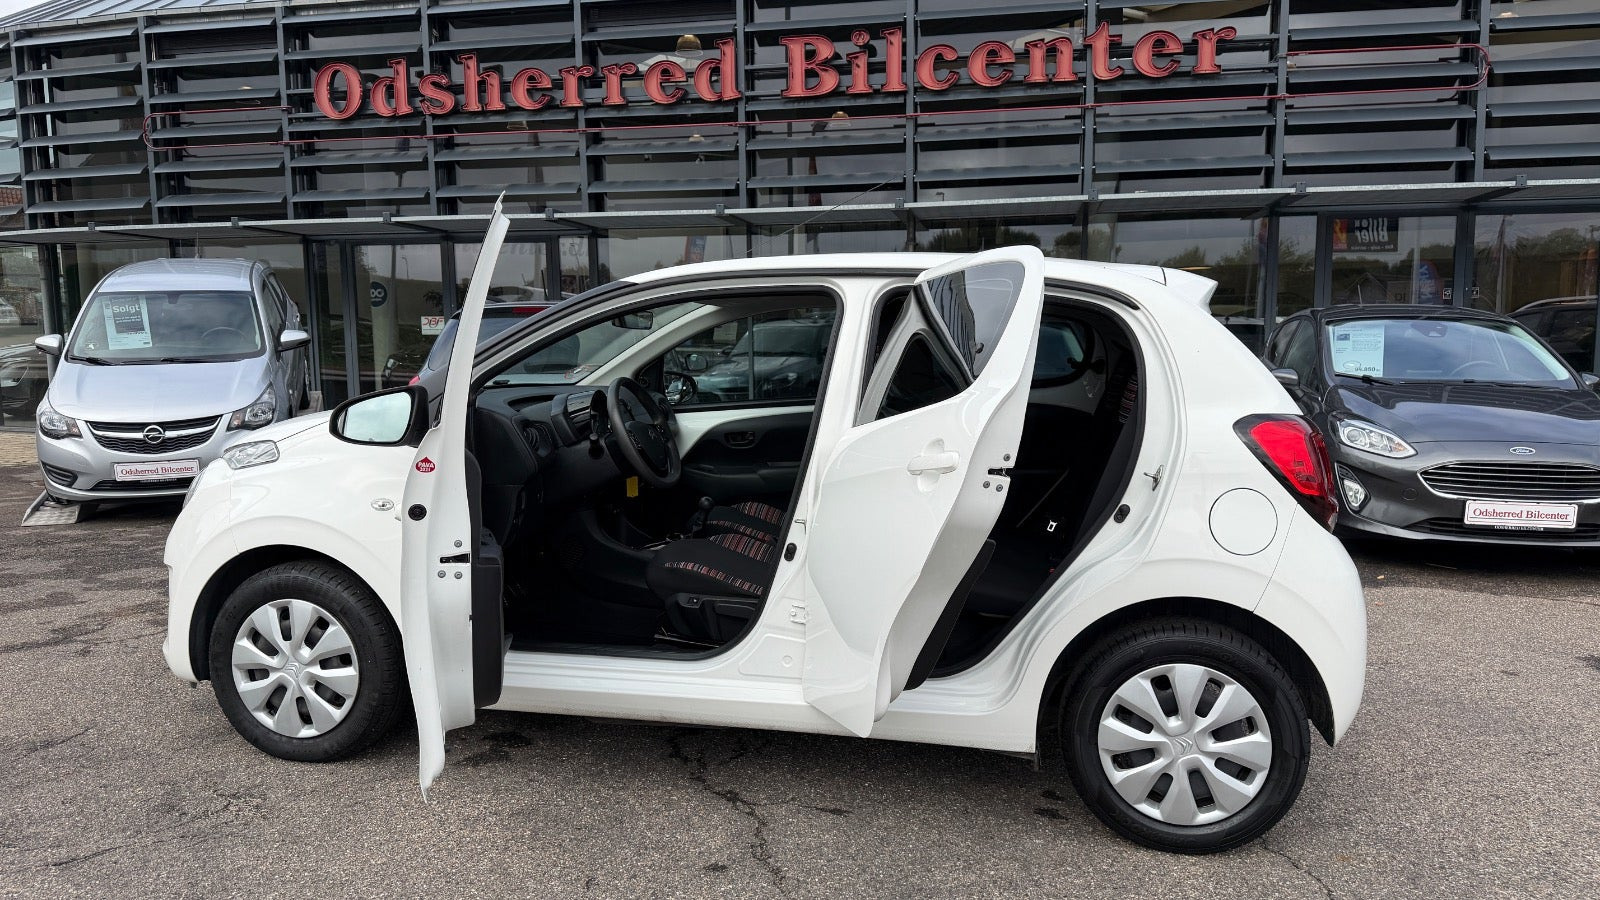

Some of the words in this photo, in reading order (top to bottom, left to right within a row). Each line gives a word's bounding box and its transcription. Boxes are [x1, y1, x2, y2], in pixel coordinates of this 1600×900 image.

[313, 38, 741, 120] Odsherred
[780, 20, 1237, 98] Bilcenter
[112, 304, 141, 313] Solgt
[1473, 507, 1522, 519] Odsherred
[1526, 510, 1570, 520] Bilcenter
